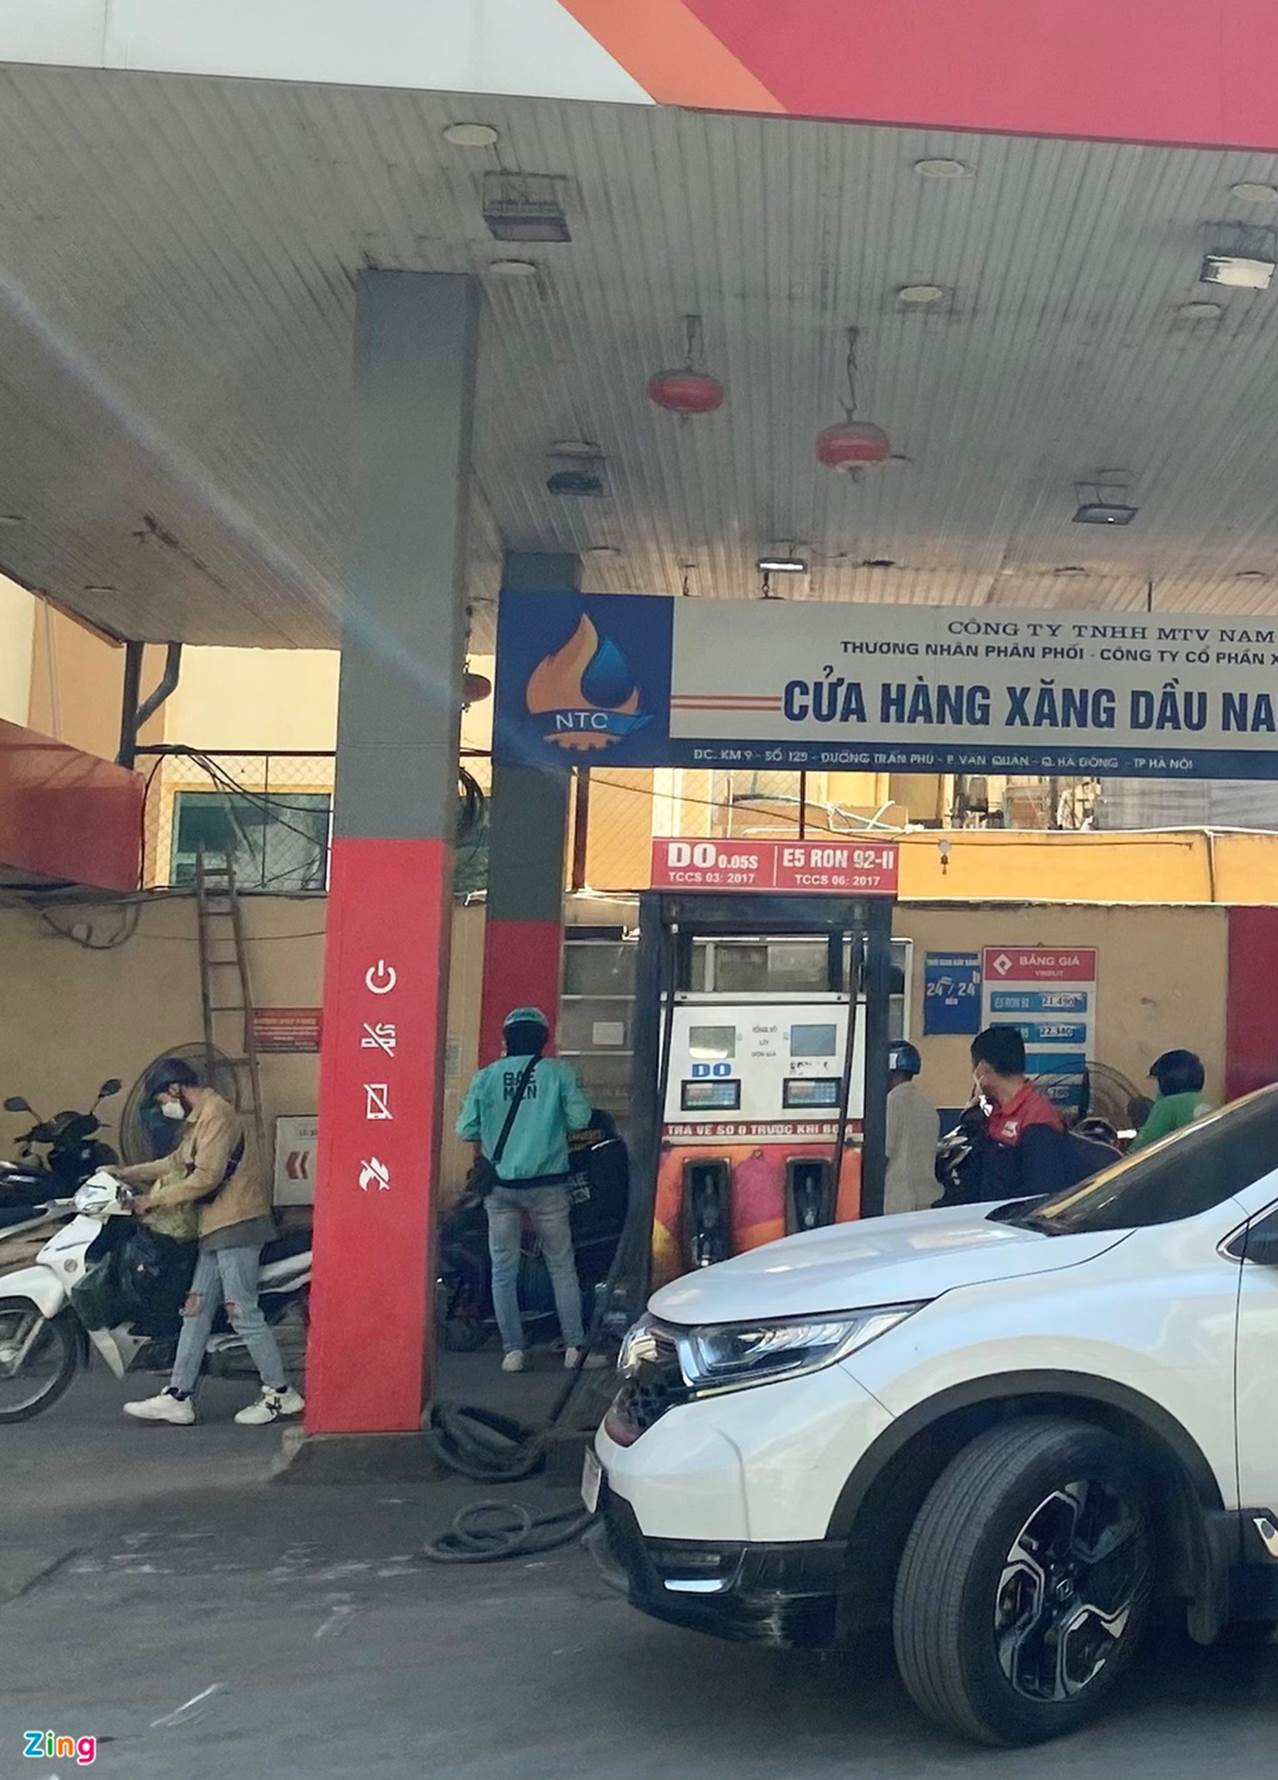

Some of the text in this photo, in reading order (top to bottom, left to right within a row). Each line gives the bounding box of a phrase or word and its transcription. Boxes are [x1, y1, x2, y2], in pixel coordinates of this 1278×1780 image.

[948, 617, 1020, 637] CÔNG
[1027, 623, 1063, 638] TY
[1072, 625, 1148, 641] TNHH
[1157, 627, 1211, 642] MTV
[1218, 630, 1276, 645] NAM
[840, 640, 919, 656] THƯƠNG
[925, 641, 979, 657] NHÂN
[985, 642, 1036, 659] PHÂN
[1042, 642, 1084, 660] PHỐI
[1100, 645, 1151, 662] CÔNG
[1158, 650, 1179, 663] TY
[1185, 644, 1210, 664] CỔ
[1216, 648, 1265, 666] PHẦN
[781, 664, 867, 723] CỬA
[880, 675, 991, 726] HÀNG
[1004, 678, 1116, 730] XĂNG
[1129, 677, 1208, 732] DẦU
[555, 712, 608, 731] NTC
[721, 750, 742, 761] KM
[764, 747, 783, 761] SỐ
[667, 842, 759, 870] DO 0.05S
[782, 848, 805, 868] E5
[810, 849, 848, 869] RON
[668, 871, 701, 882] TCCS
[727, 873, 755, 883] 2017
[794, 874, 829, 885] TCCS
[853, 876, 881, 887] 2017
[1019, 953, 1080, 967] BẢNG GIÁ
[691, 1062, 732, 1078] DO
[503, 1085, 538, 1102] MN
